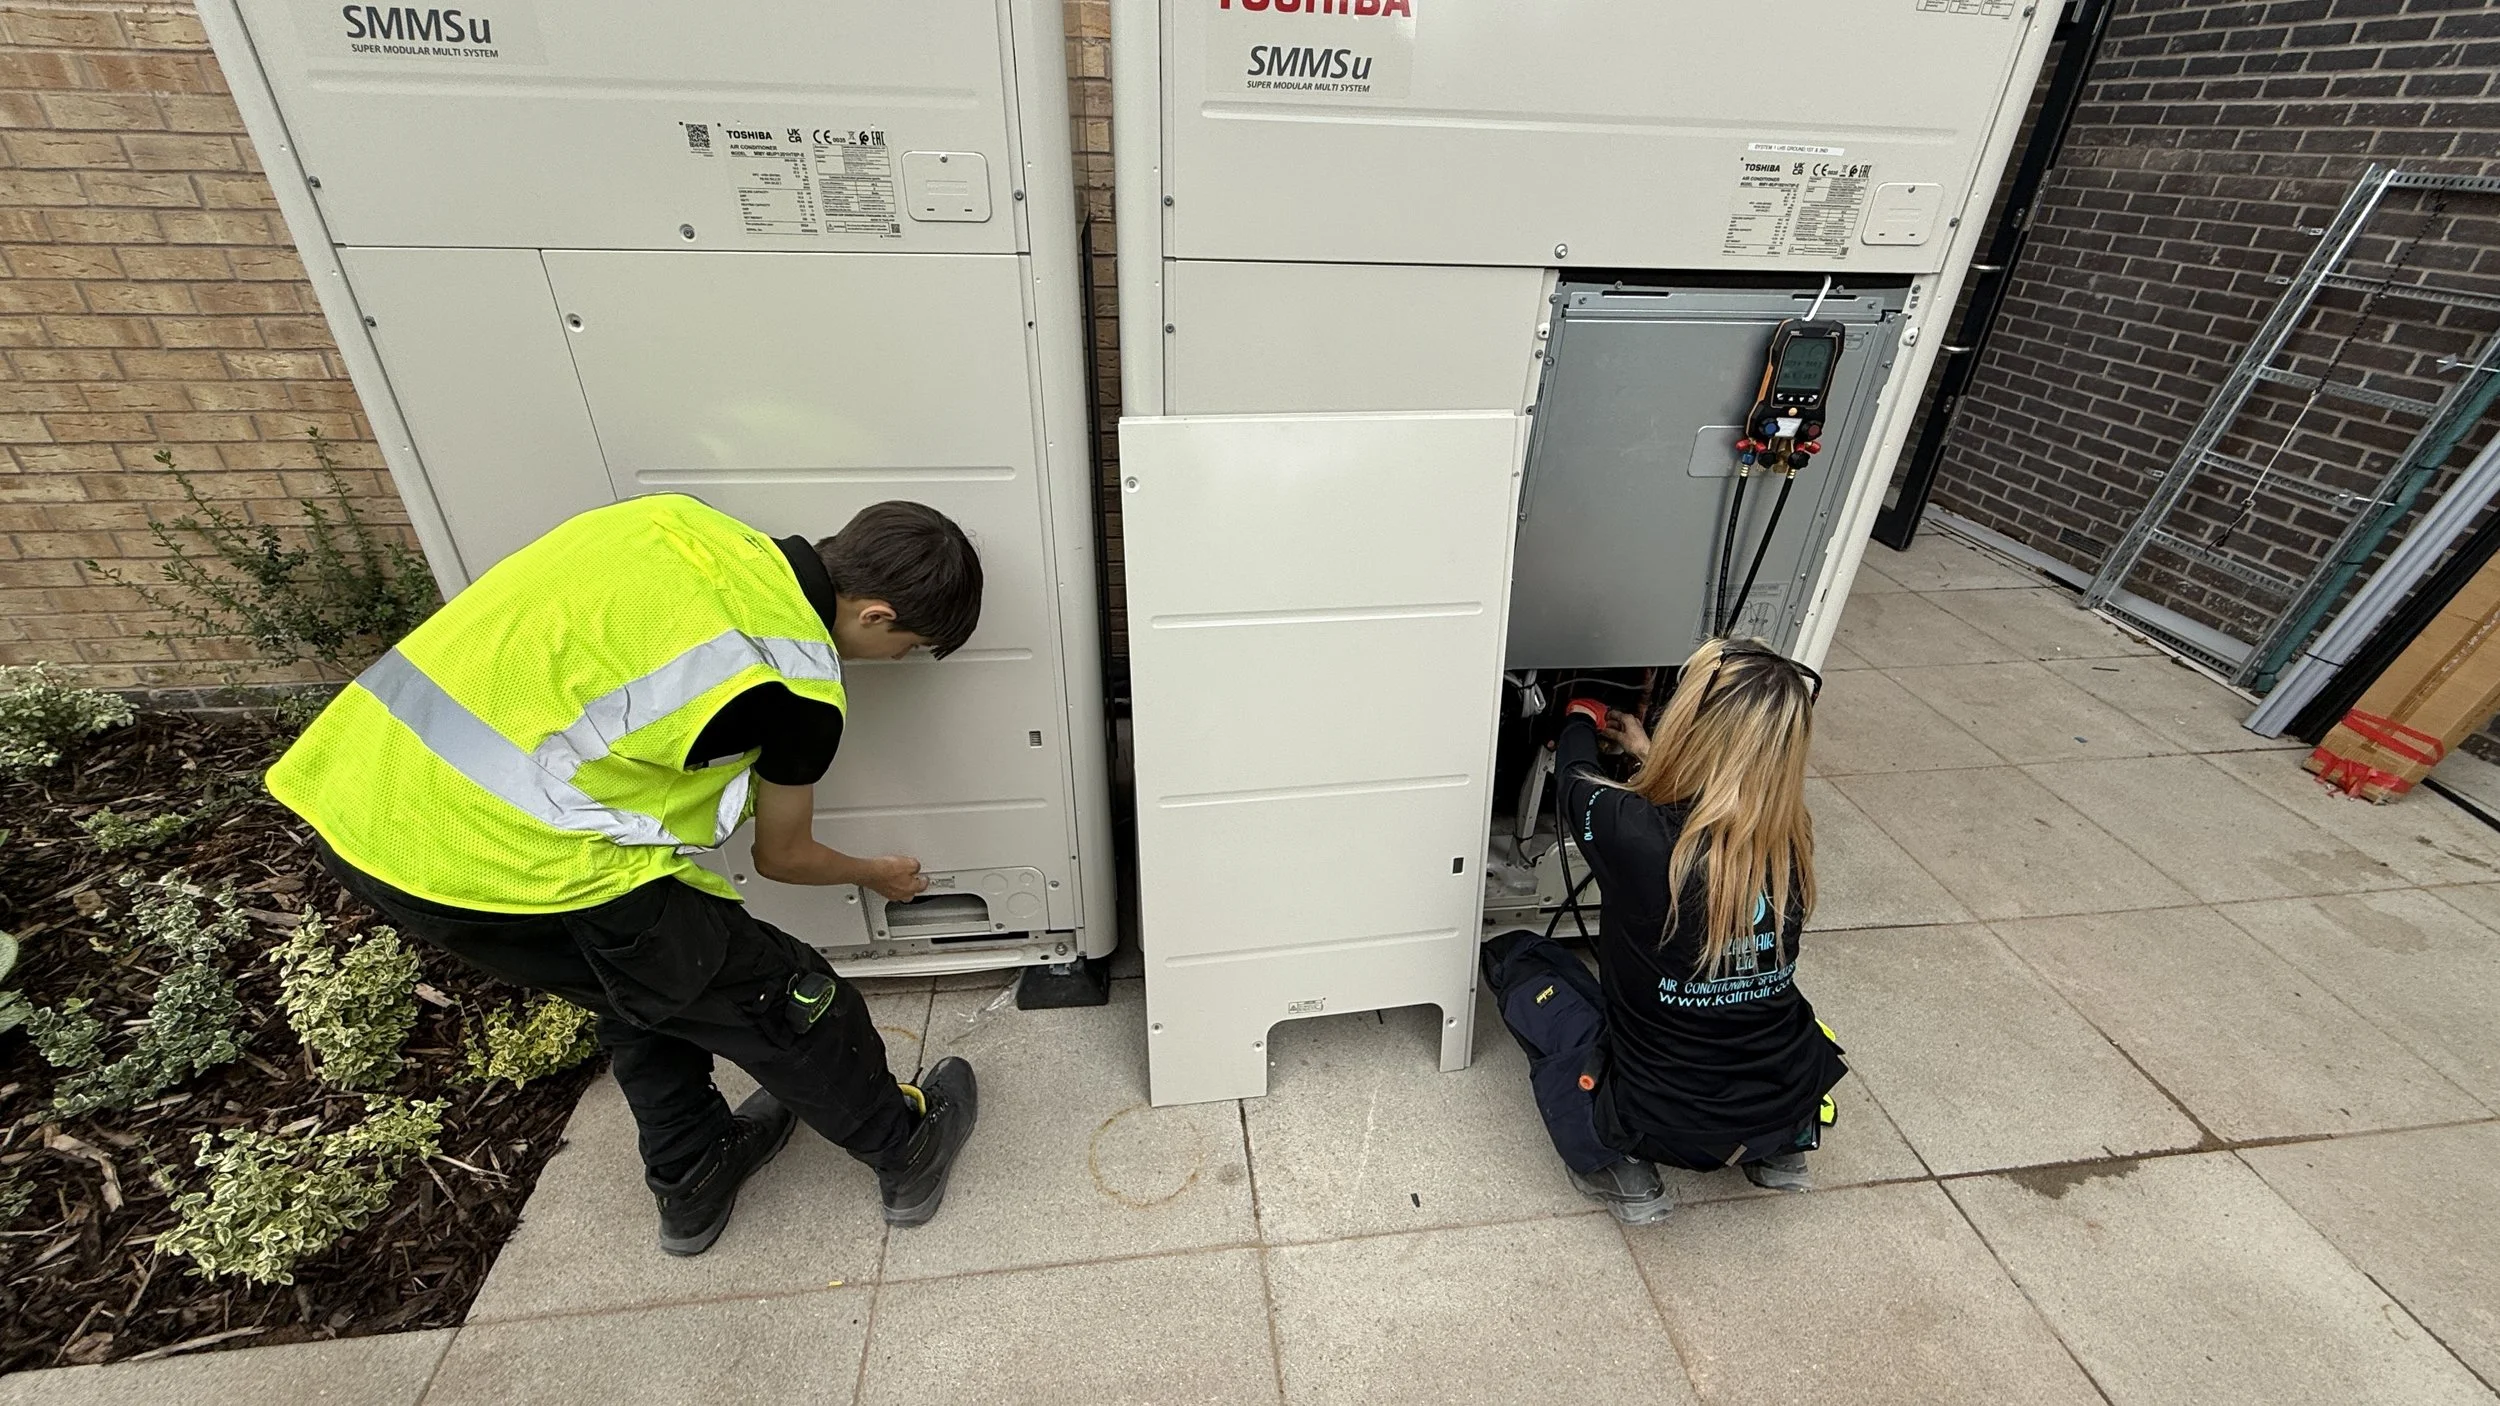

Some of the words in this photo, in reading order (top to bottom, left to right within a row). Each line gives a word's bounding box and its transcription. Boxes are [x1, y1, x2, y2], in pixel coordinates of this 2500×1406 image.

[342, 5, 491, 44] SMMSu
[351, 44, 381, 53] SUPER
[383, 45, 431, 55] MODULAR
[432, 47, 461, 56] MULTI
[463, 48, 499, 58] SYSTEM
[1247, 45, 1372, 80] SMMSu
[1247, 80, 1272, 89] SUPER
[1273, 81, 1313, 91] MODULAR
[1314, 82, 1339, 91] MULTI
[1340, 83, 1370, 93] SYSTEM
[726, 130, 773, 140] TOSHIBA
[1745, 163, 1781, 172] TOSHIBA
[1658, 977, 1678, 993] AIR
[1684, 978, 1755, 995] CONDITIONING
[1659, 979, 1790, 1007] www.kalmair.co
